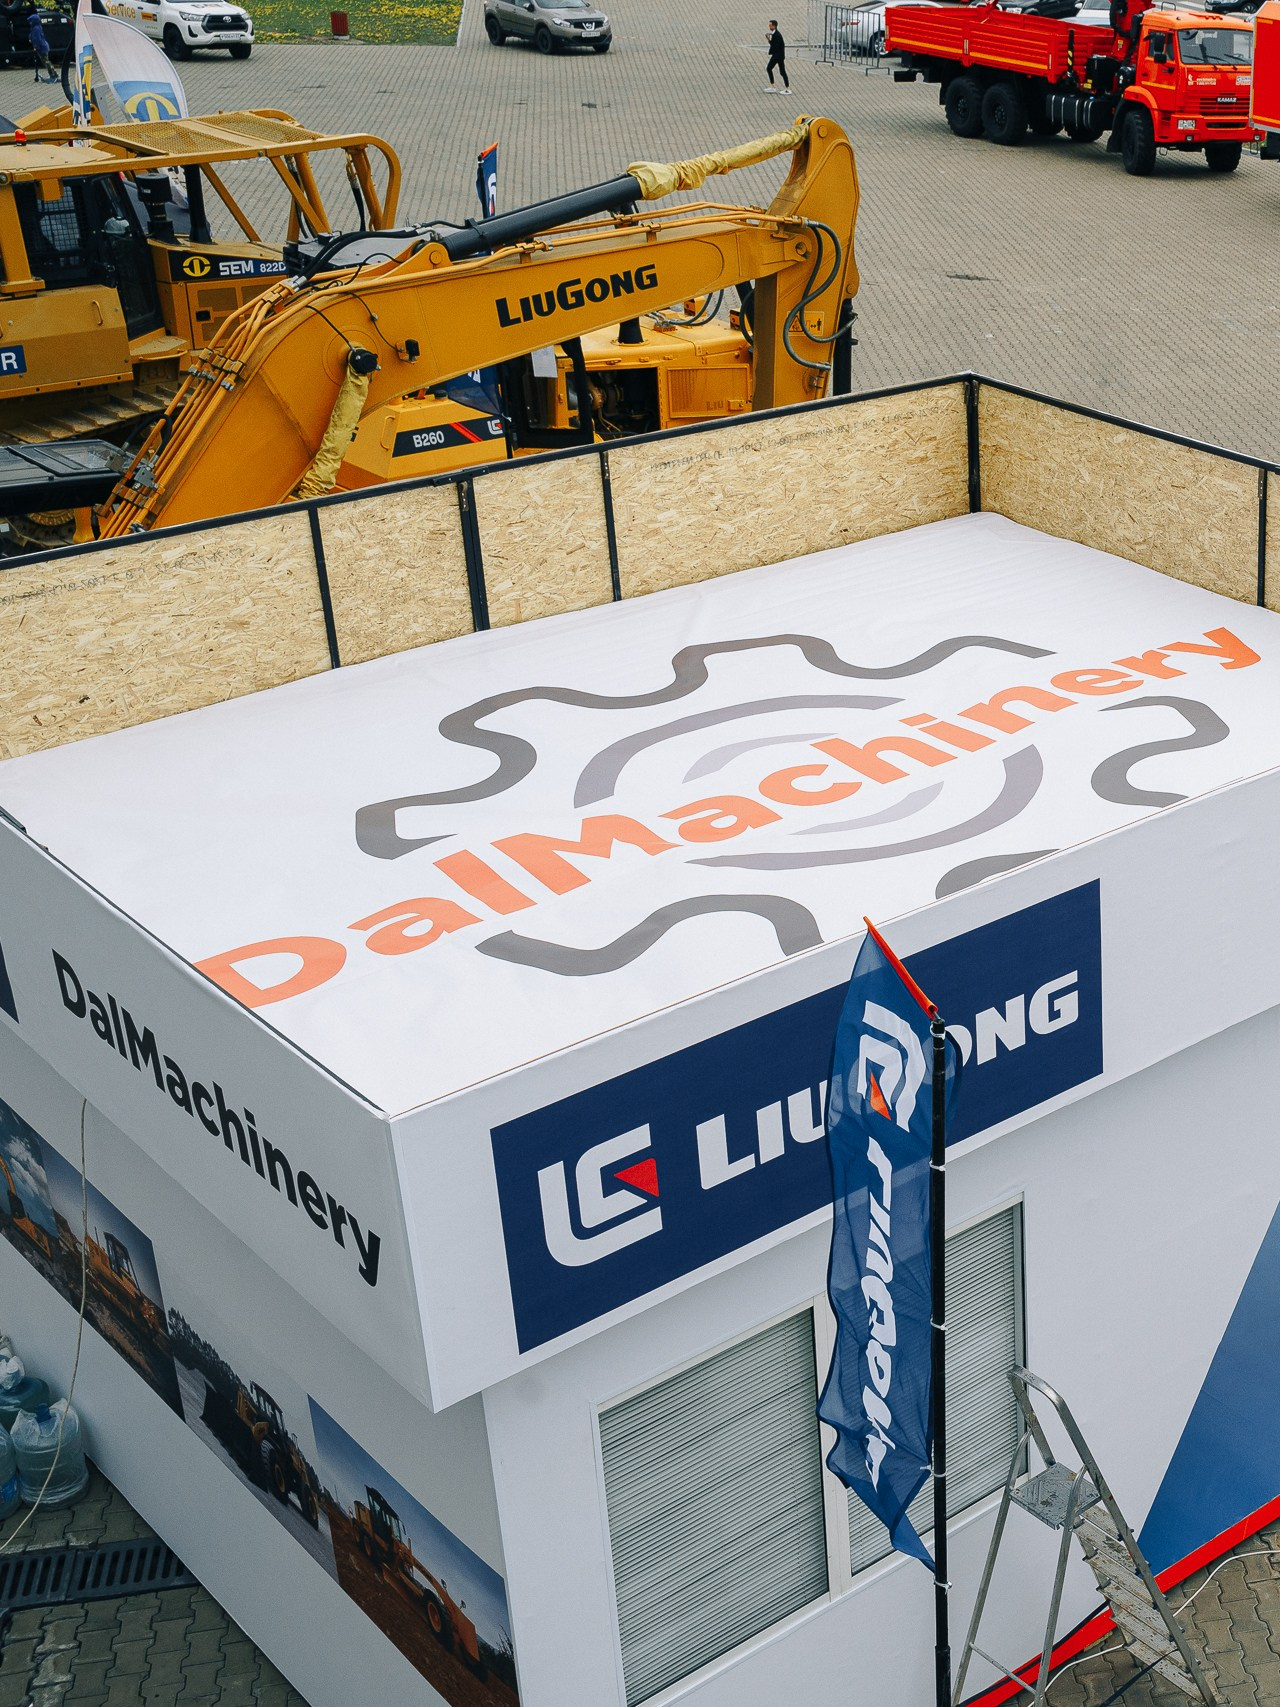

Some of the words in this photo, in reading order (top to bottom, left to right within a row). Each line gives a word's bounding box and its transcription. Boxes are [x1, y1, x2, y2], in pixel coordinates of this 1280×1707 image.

[106, 0, 136, 19] Service
[219, 260, 254, 276] SEM
[260, 262, 287, 273] 822D
[412, 430, 445, 448] B260
[192, 626, 1262, 1009] DalMachinery
[52, 948, 381, 1288] DalMachinery
